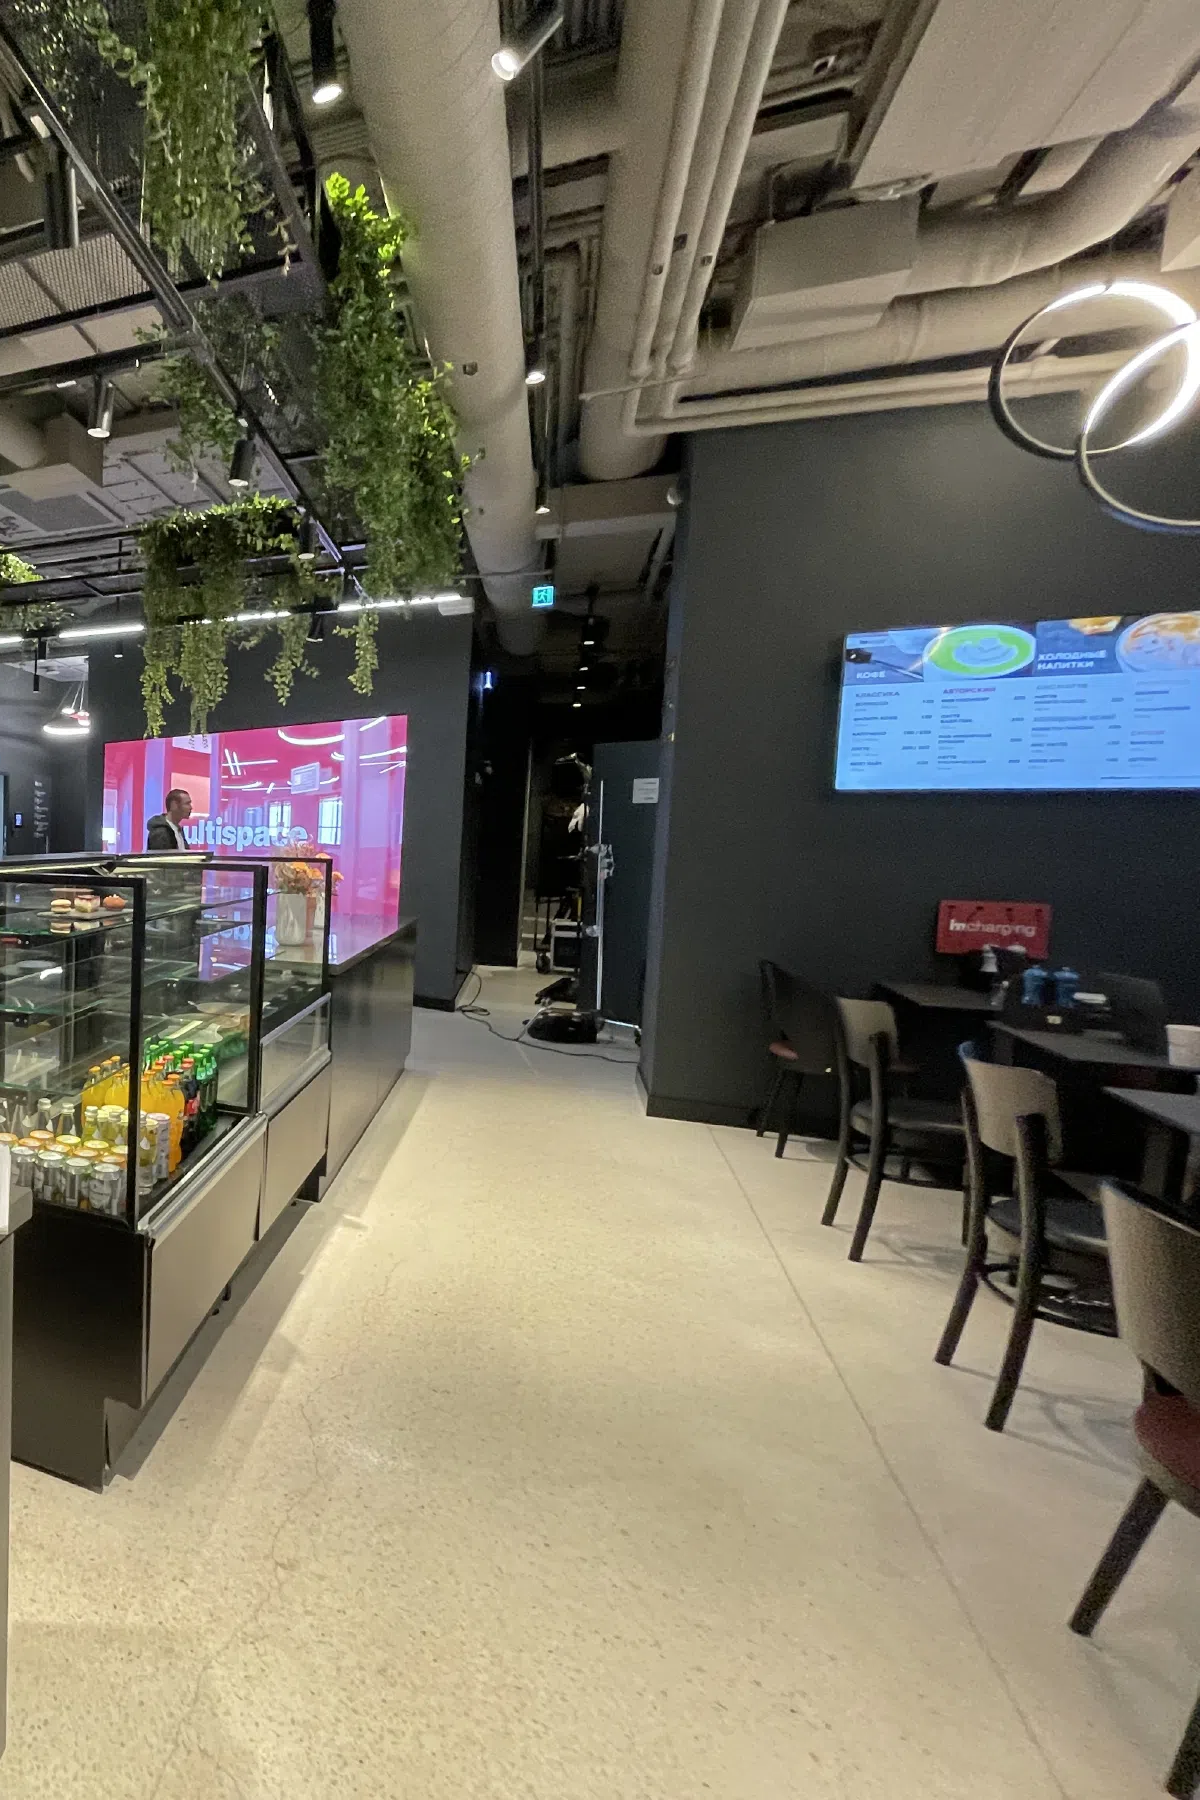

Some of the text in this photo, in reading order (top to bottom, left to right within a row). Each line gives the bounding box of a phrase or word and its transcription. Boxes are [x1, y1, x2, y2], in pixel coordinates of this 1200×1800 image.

[1038, 650, 1107, 661] ХОЛОДНЫЕ
[1037, 661, 1095, 670] НАПИТКИ
[856, 670, 887, 679] КОФЕ
[183, 816, 308, 852] ultispace
